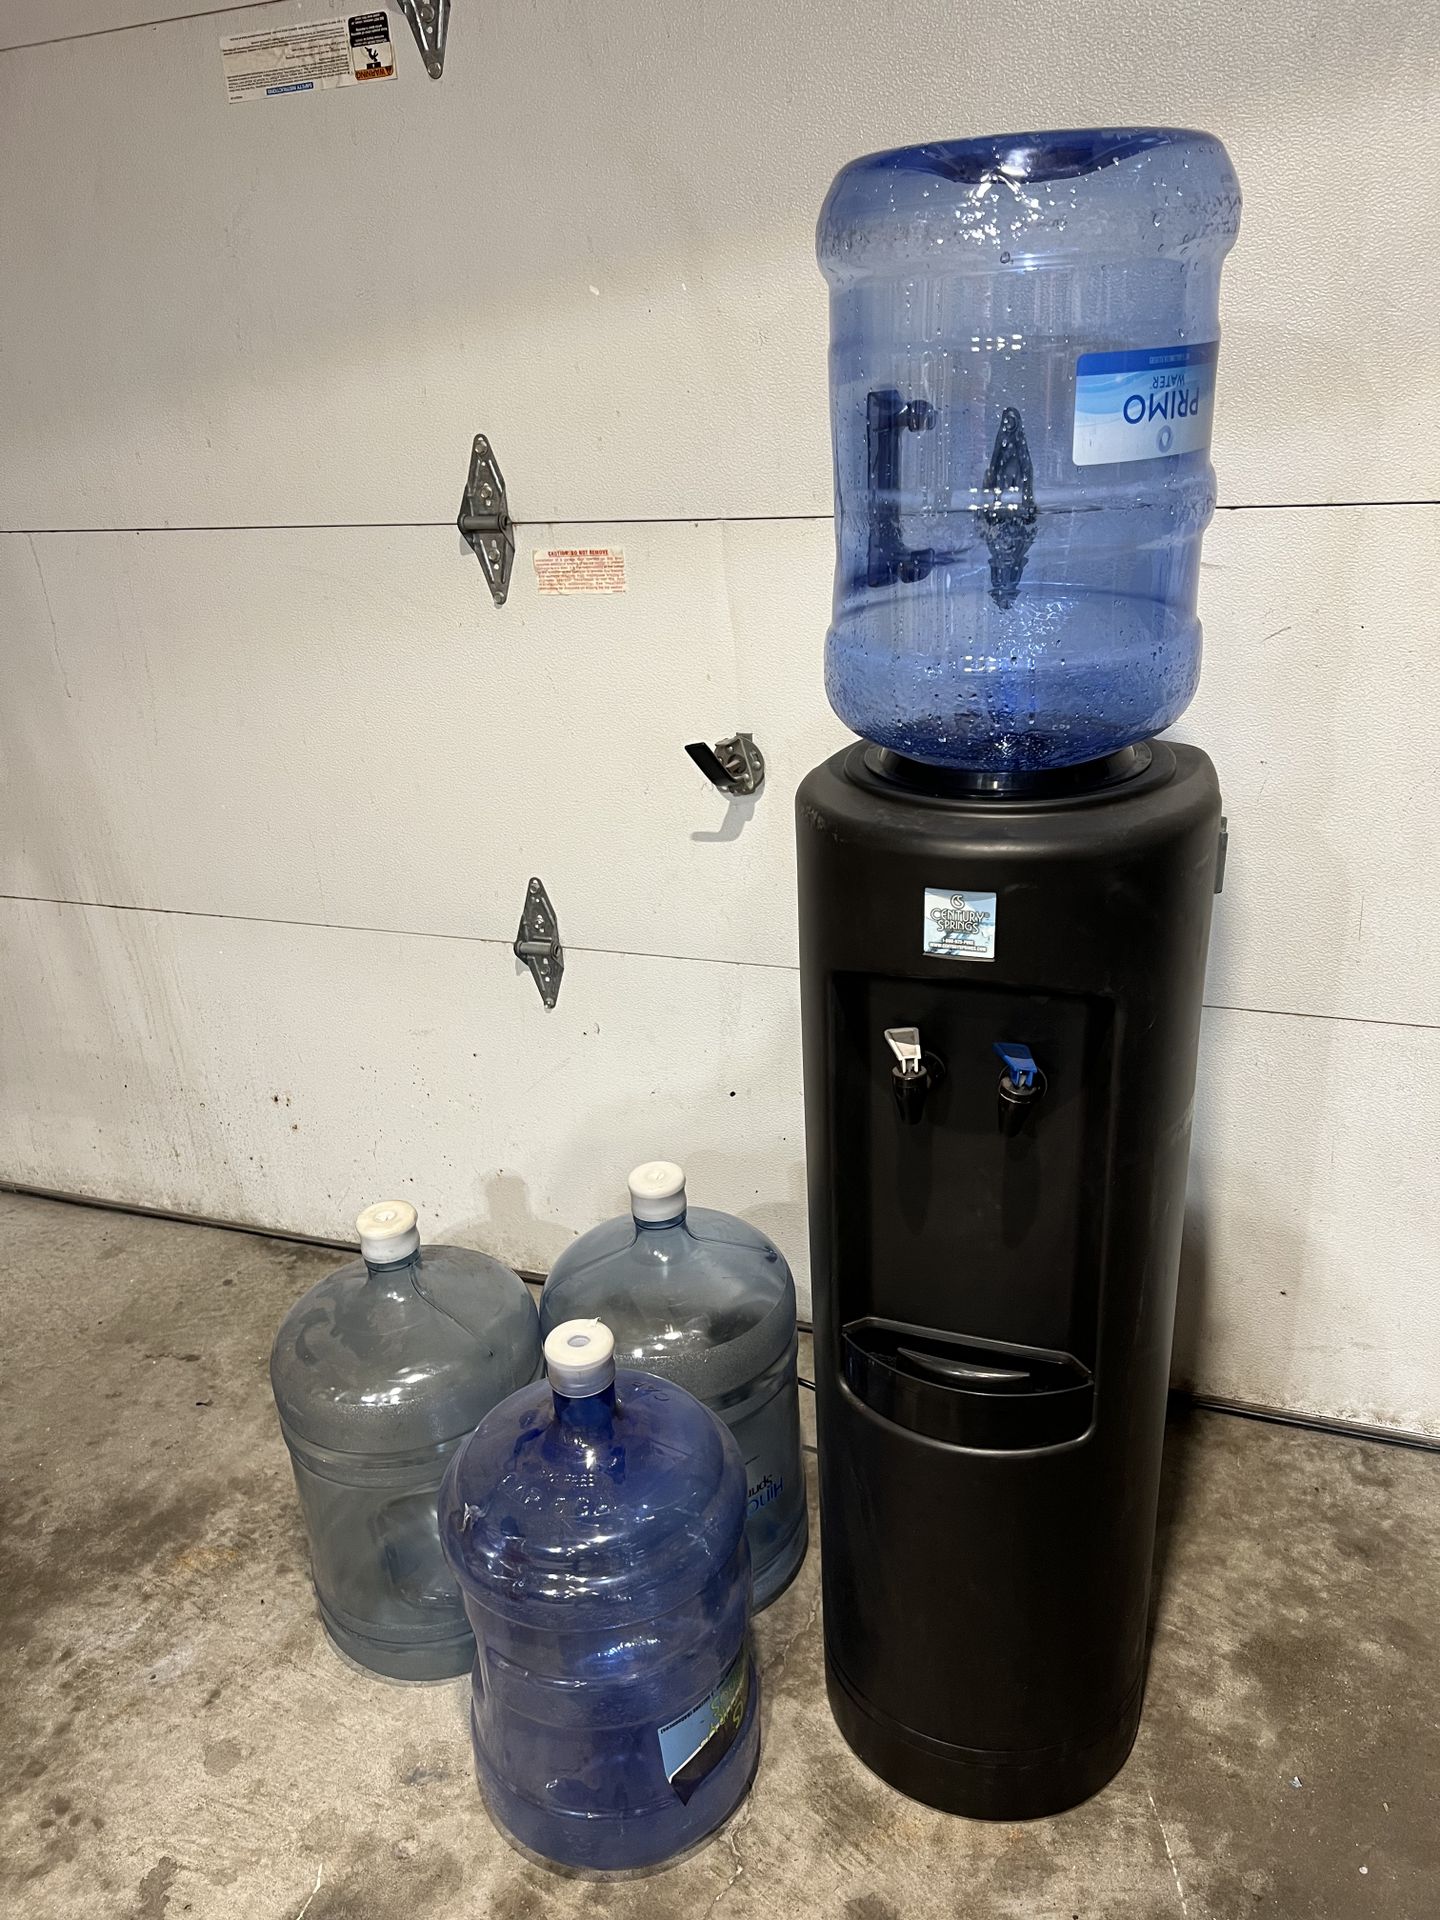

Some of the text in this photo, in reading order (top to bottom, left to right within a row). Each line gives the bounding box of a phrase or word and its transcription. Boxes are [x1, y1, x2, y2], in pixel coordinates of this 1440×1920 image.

[355, 68, 386, 80] WARNING
[296, 82, 313, 91] SAFETY
[1152, 374, 1185, 389] WATER
[1123, 387, 1200, 424] PRIMO
[936, 919, 980, 935] SPRINGS
